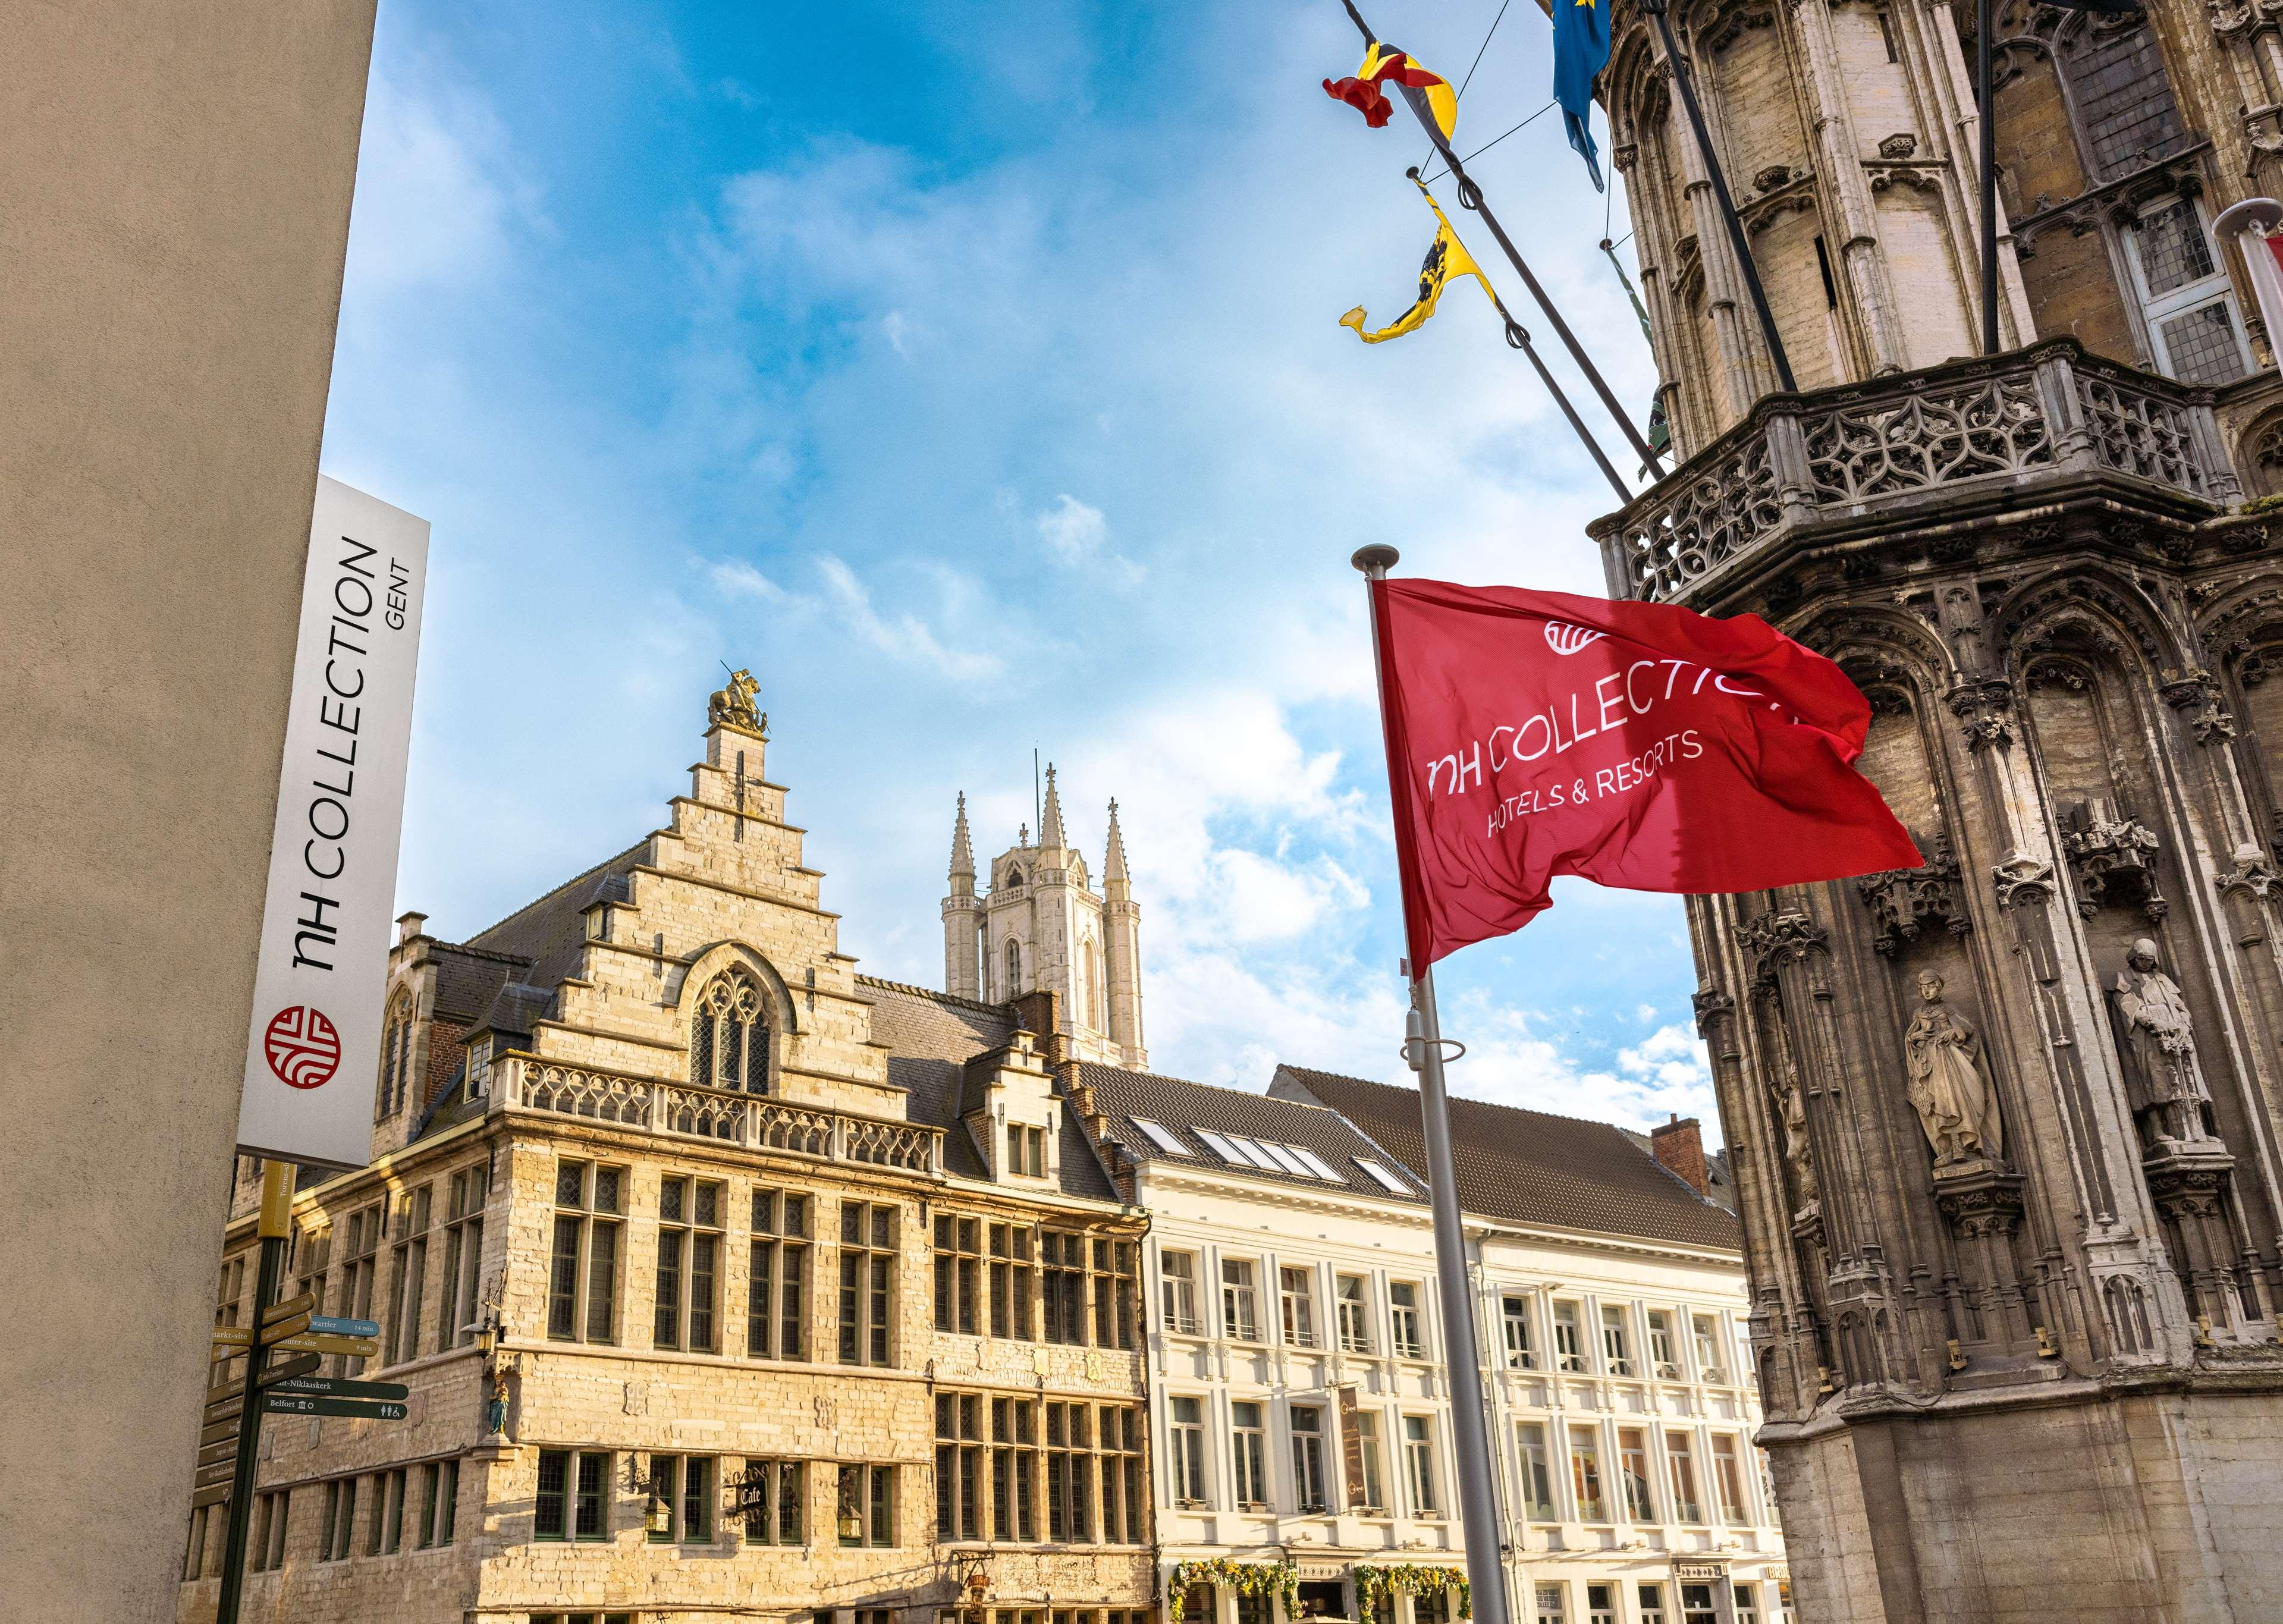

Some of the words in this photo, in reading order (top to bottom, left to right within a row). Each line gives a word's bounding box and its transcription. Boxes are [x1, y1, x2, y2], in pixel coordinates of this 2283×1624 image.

[385, 557, 411, 630] GENT
[304, 536, 378, 879] COLLECTION
[1488, 659, 1799, 773] COLLECTI
[1487, 784, 1566, 838] HOTELS
[1572, 778, 1590, 805] &
[1596, 729, 1704, 799] RESORTS
[270, 1399, 296, 1408] Belfort
